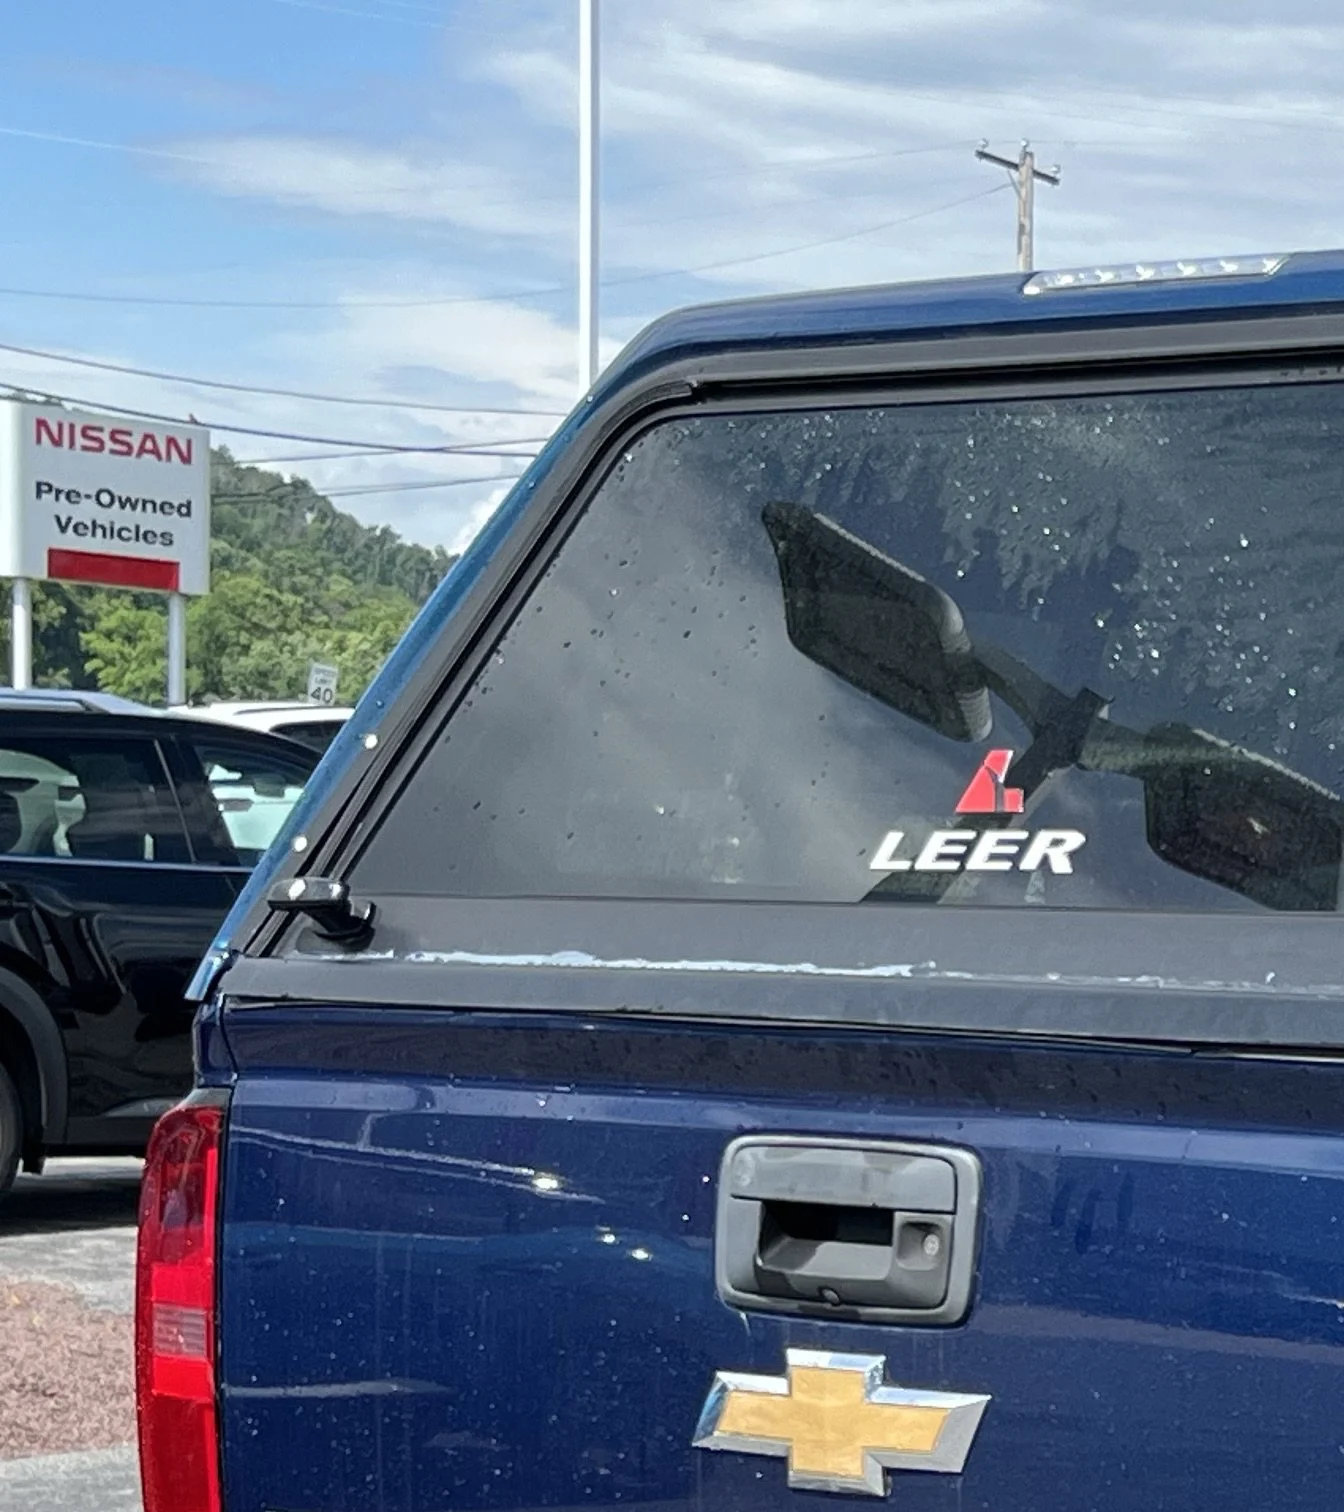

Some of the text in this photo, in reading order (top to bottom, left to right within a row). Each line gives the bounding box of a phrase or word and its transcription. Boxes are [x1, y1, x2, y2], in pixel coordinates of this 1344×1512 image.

[35, 417, 193, 466] NISSAN
[35, 481, 193, 519] Pre-Owned
[54, 514, 175, 547] Vehicles
[311, 686, 334, 704] 40
[869, 828, 1087, 875] LEER
